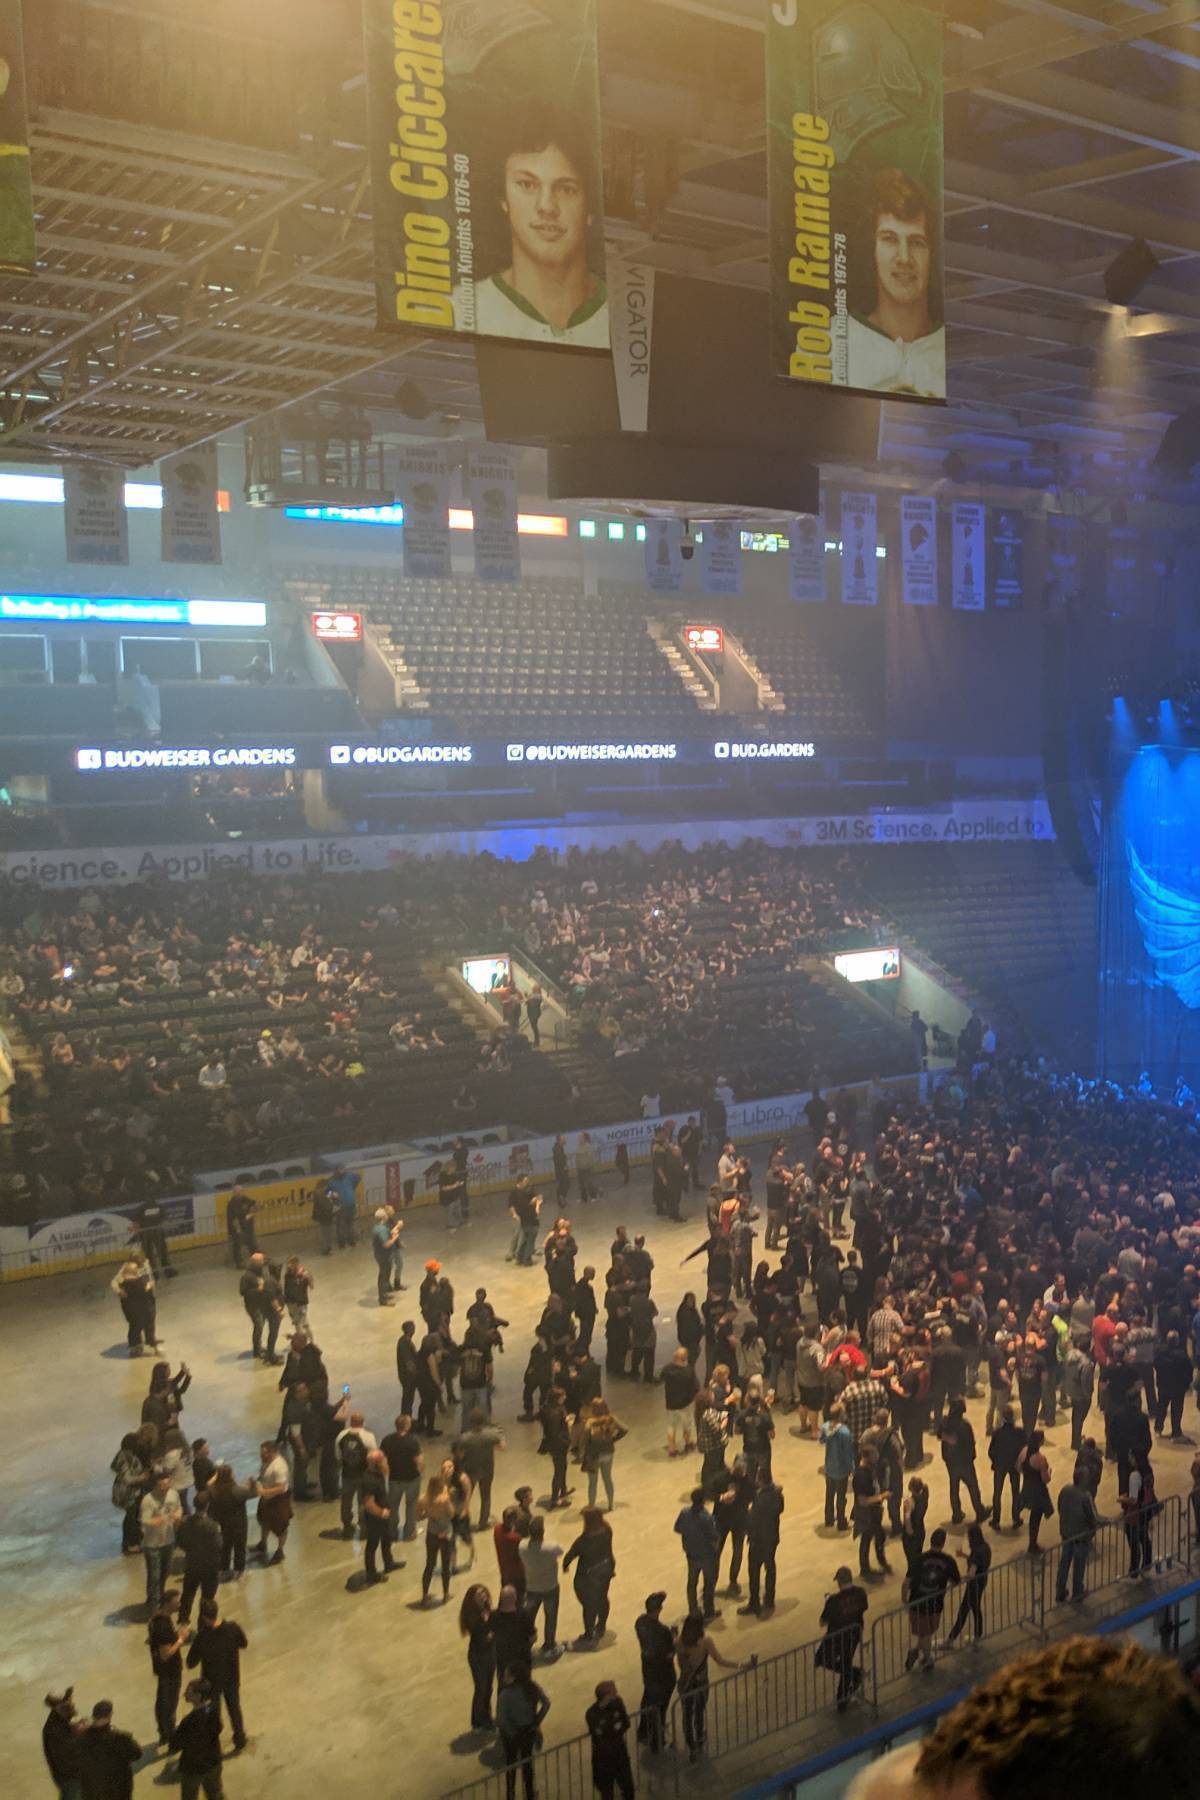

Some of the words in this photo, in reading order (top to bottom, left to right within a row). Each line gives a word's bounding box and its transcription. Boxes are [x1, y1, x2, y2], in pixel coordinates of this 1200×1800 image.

[389, 0, 449, 200] Ciccare
[454, 154, 471, 214] 1976-80
[788, 112, 837, 290] Ramage
[395, 212, 454, 328] Dino
[456, 218, 474, 274] Knights
[834, 233, 848, 285] 1975-78
[459, 277, 476, 331] London
[834, 288, 849, 339] Knights
[788, 300, 833, 383] Rob
[104, 748, 210, 768] BUDWEISER
[213, 747, 296, 767] GARDENS
[353, 745, 472, 763] @BUDGARDENS
[526, 744, 677, 761] @BUDWEISERGARDENS
[731, 742, 815, 758] BUD.GARDENS
[816, 819, 847, 841] 3M
[854, 817, 938, 840] Science.
[944, 814, 1019, 840] Applied
[1025, 815, 1045, 836] to
[137, 845, 255, 881] Applied
[264, 847, 293, 871] to
[608, 1127, 644, 1140] NORTH
[743, 1104, 785, 1125] Libro
